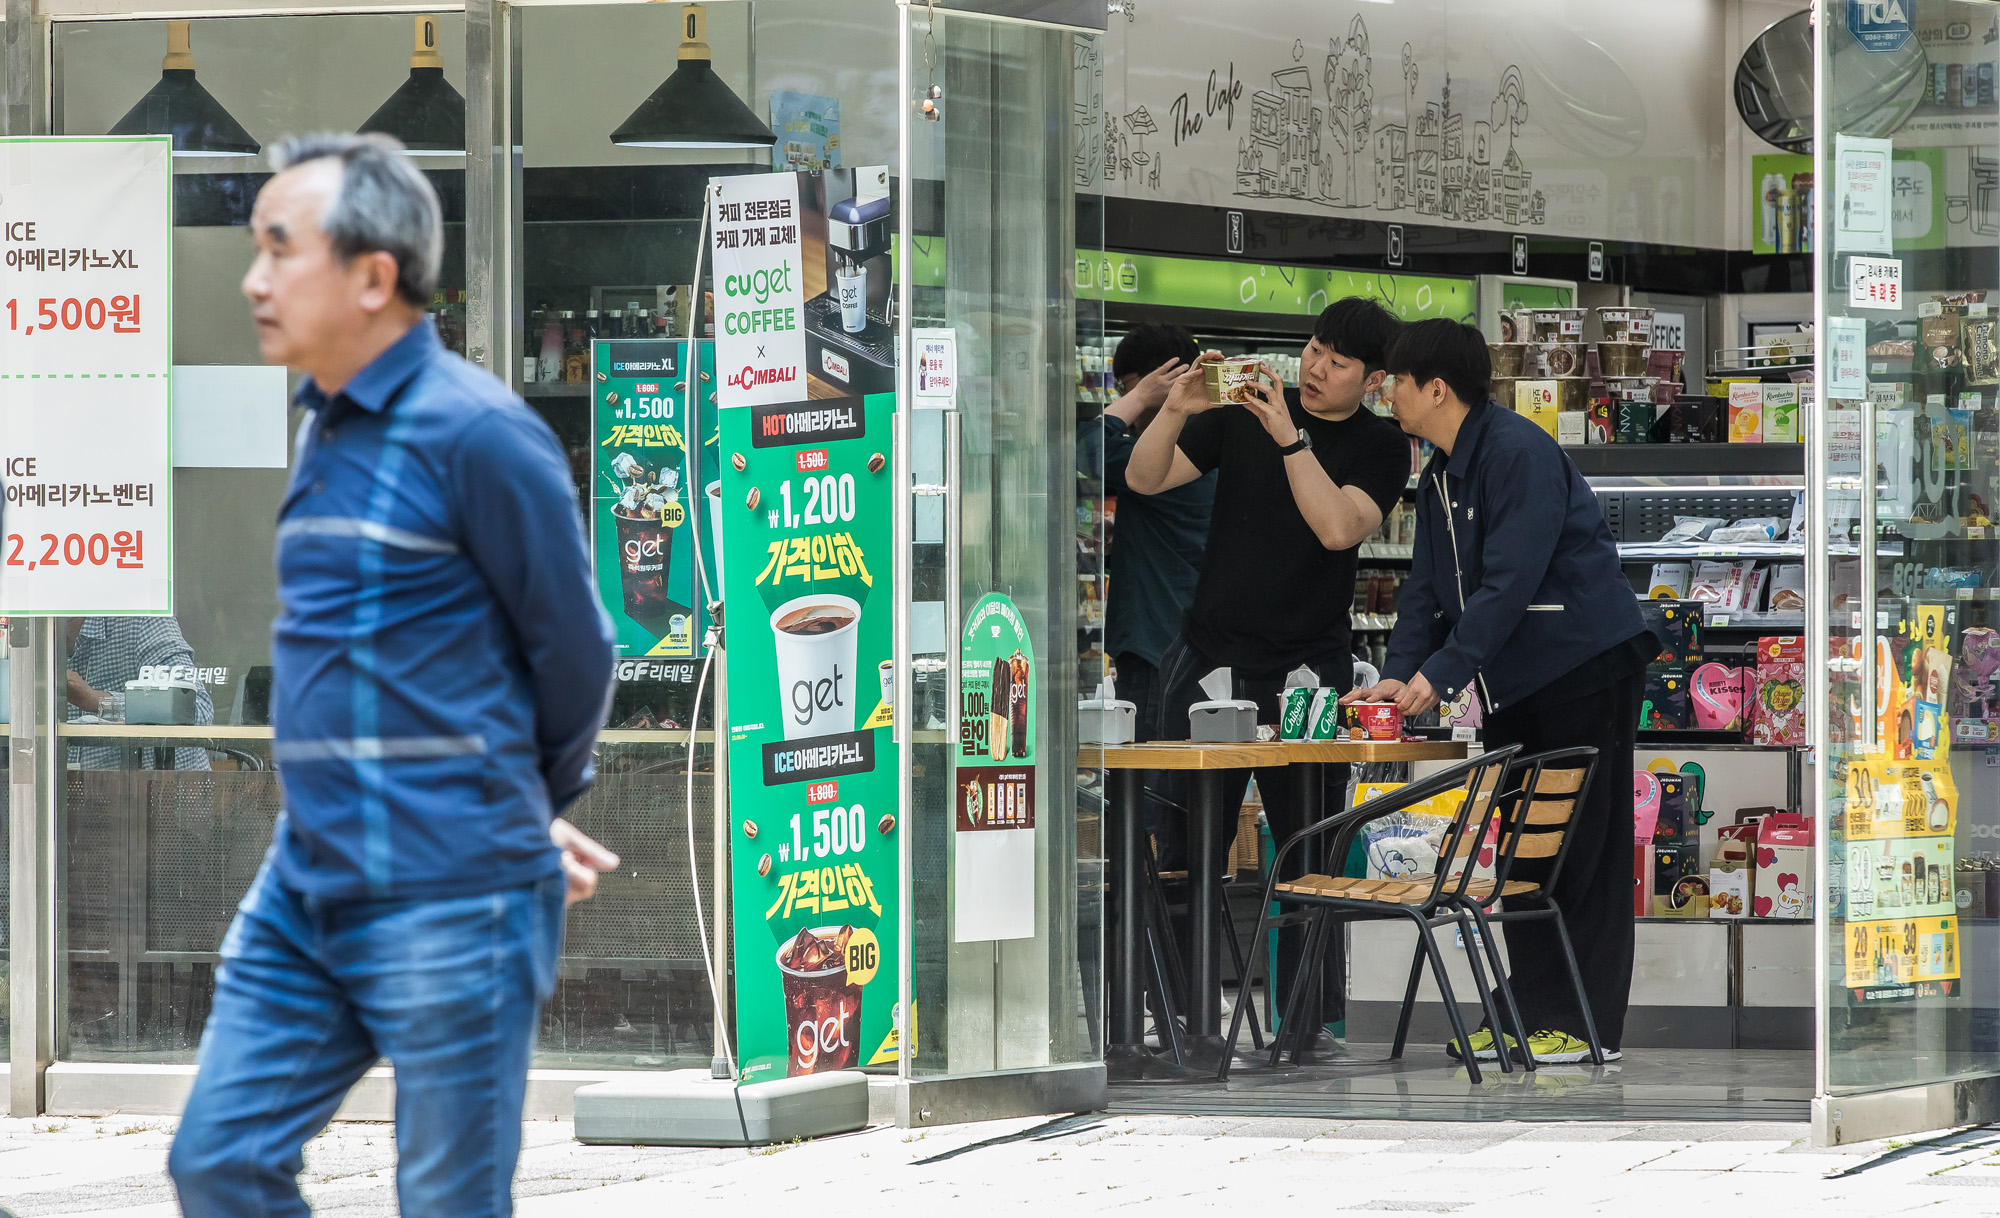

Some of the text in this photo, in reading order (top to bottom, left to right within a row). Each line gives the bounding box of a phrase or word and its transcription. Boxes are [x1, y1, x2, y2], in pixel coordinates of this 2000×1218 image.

[1170, 61, 1243, 147] The Cafe
[719, 199, 792, 223] 커피 전문점급
[5, 222, 36, 242] ICE
[716, 223, 797, 250] 커피 기계 교체!
[5, 248, 139, 272] 아메리카노XL
[841, 285, 857, 302] get
[842, 301, 858, 309] COFFEE
[6, 294, 141, 336] 1,500원
[724, 308, 796, 335] COFFEE
[1532, 388, 1542, 414] 보리차
[1732, 390, 1760, 401] Kombucha
[1766, 390, 1794, 401] Kombucha
[602, 425, 687, 452] 가격인하
[5, 457, 37, 477] ICE
[6, 482, 155, 508] 아메리카노벤티
[663, 508, 682, 522] BIG
[6, 530, 144, 571] 2,200원
[625, 533, 664, 563] get
[755, 531, 873, 588] 가격인하
[138, 665, 227, 686] BGF리테일
[792, 663, 844, 727] get
[1010, 682, 1026, 704] get
[1284, 695, 1306, 734] Chilsung
[961, 720, 989, 756] 할인
[765, 862, 882, 921] 가격인하
[849, 943, 877, 973] BIG
[797, 1001, 850, 1069] get
